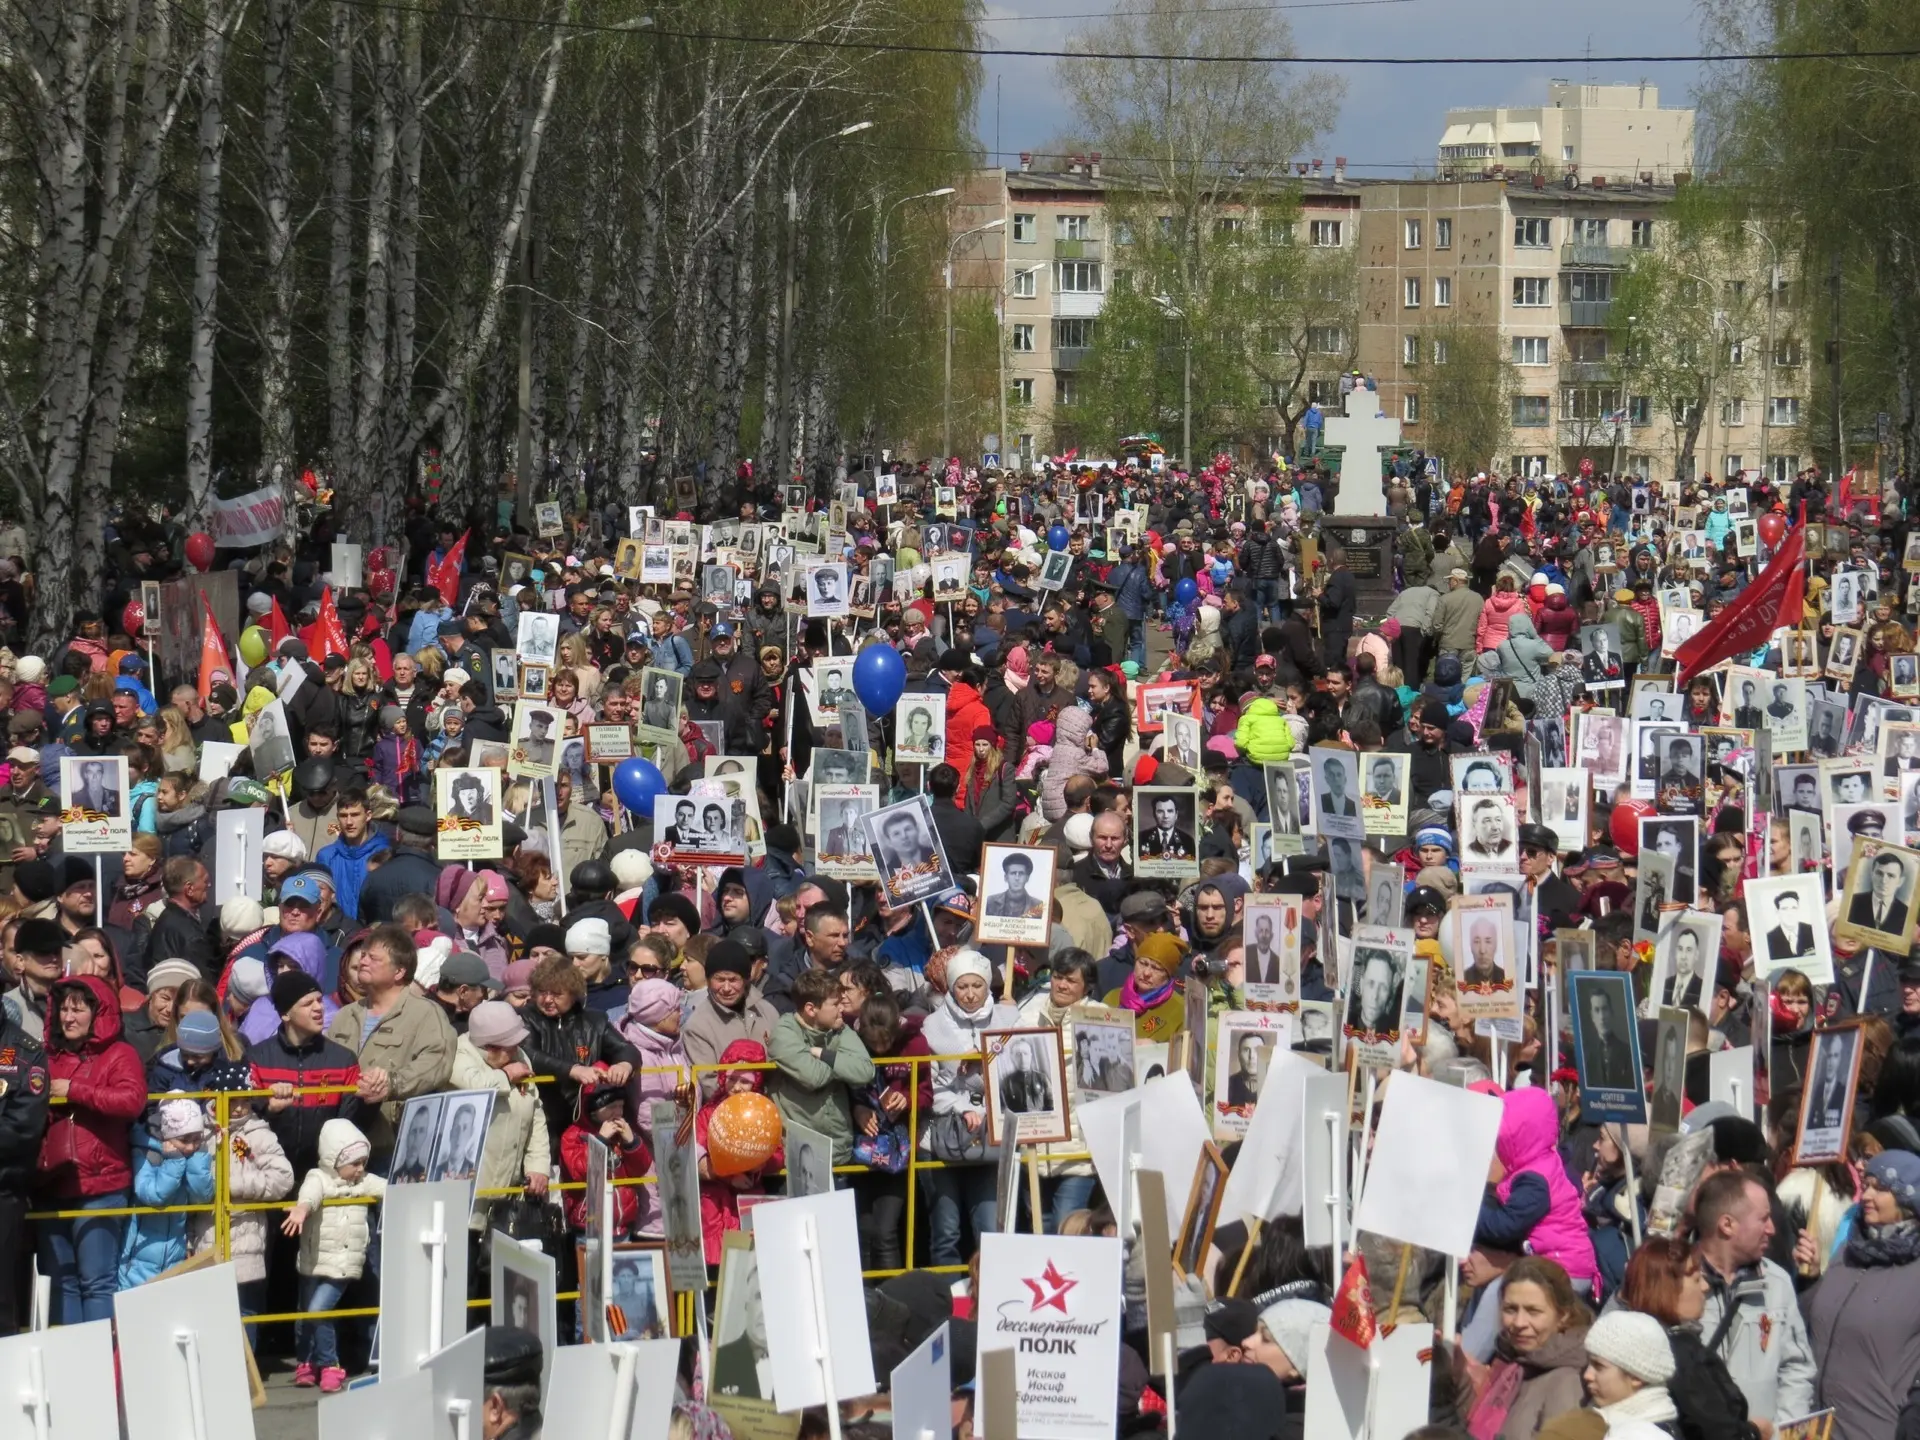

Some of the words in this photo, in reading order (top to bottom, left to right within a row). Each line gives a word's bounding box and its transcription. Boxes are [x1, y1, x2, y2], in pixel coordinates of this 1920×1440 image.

[996, 1300, 1109, 1337] бессмертный
[1019, 1336, 1077, 1355] ПОЛК
[1027, 1368, 1066, 1380] Исаков
[1028, 1379, 1064, 1394] Иосиф
